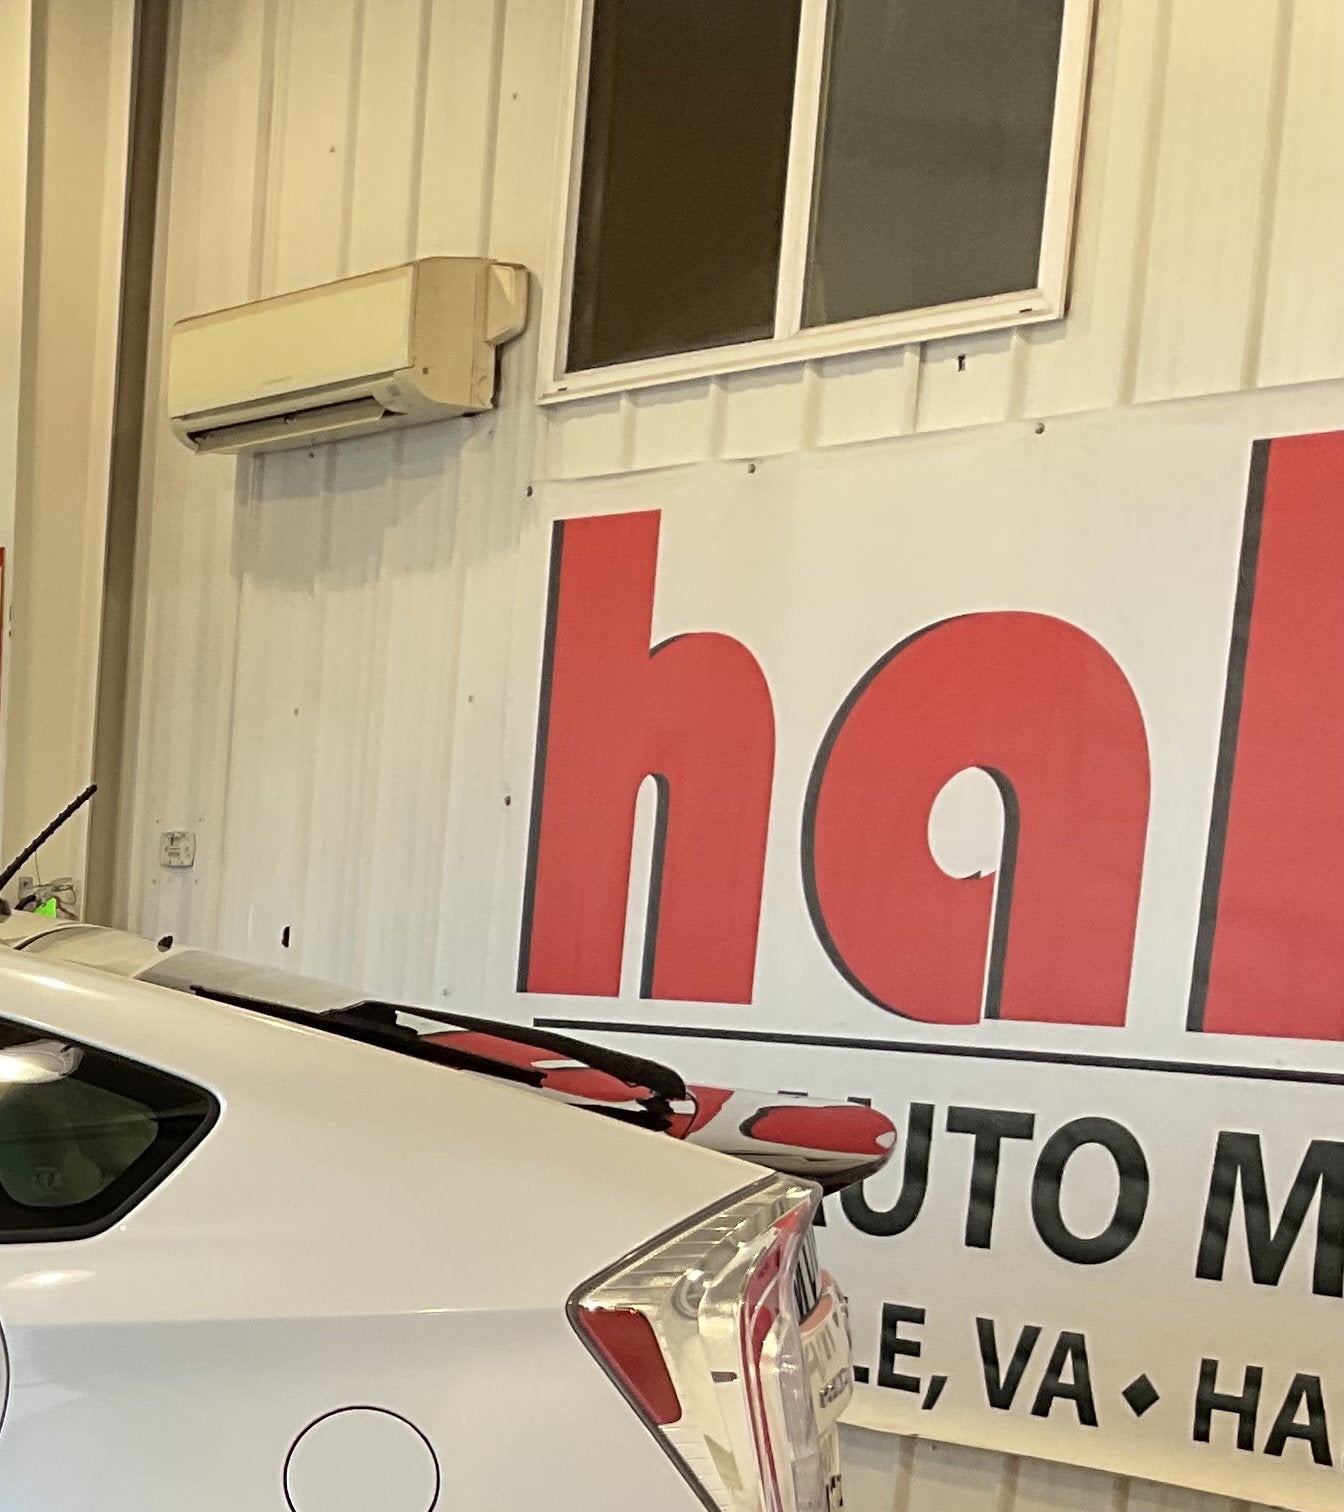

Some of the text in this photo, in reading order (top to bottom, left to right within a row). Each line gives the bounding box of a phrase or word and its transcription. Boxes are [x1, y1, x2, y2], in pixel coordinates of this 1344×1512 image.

[777, 1089, 1150, 1265] UTO
[975, 1316, 1099, 1428] VA
[1192, 1357, 1333, 1467] HA
